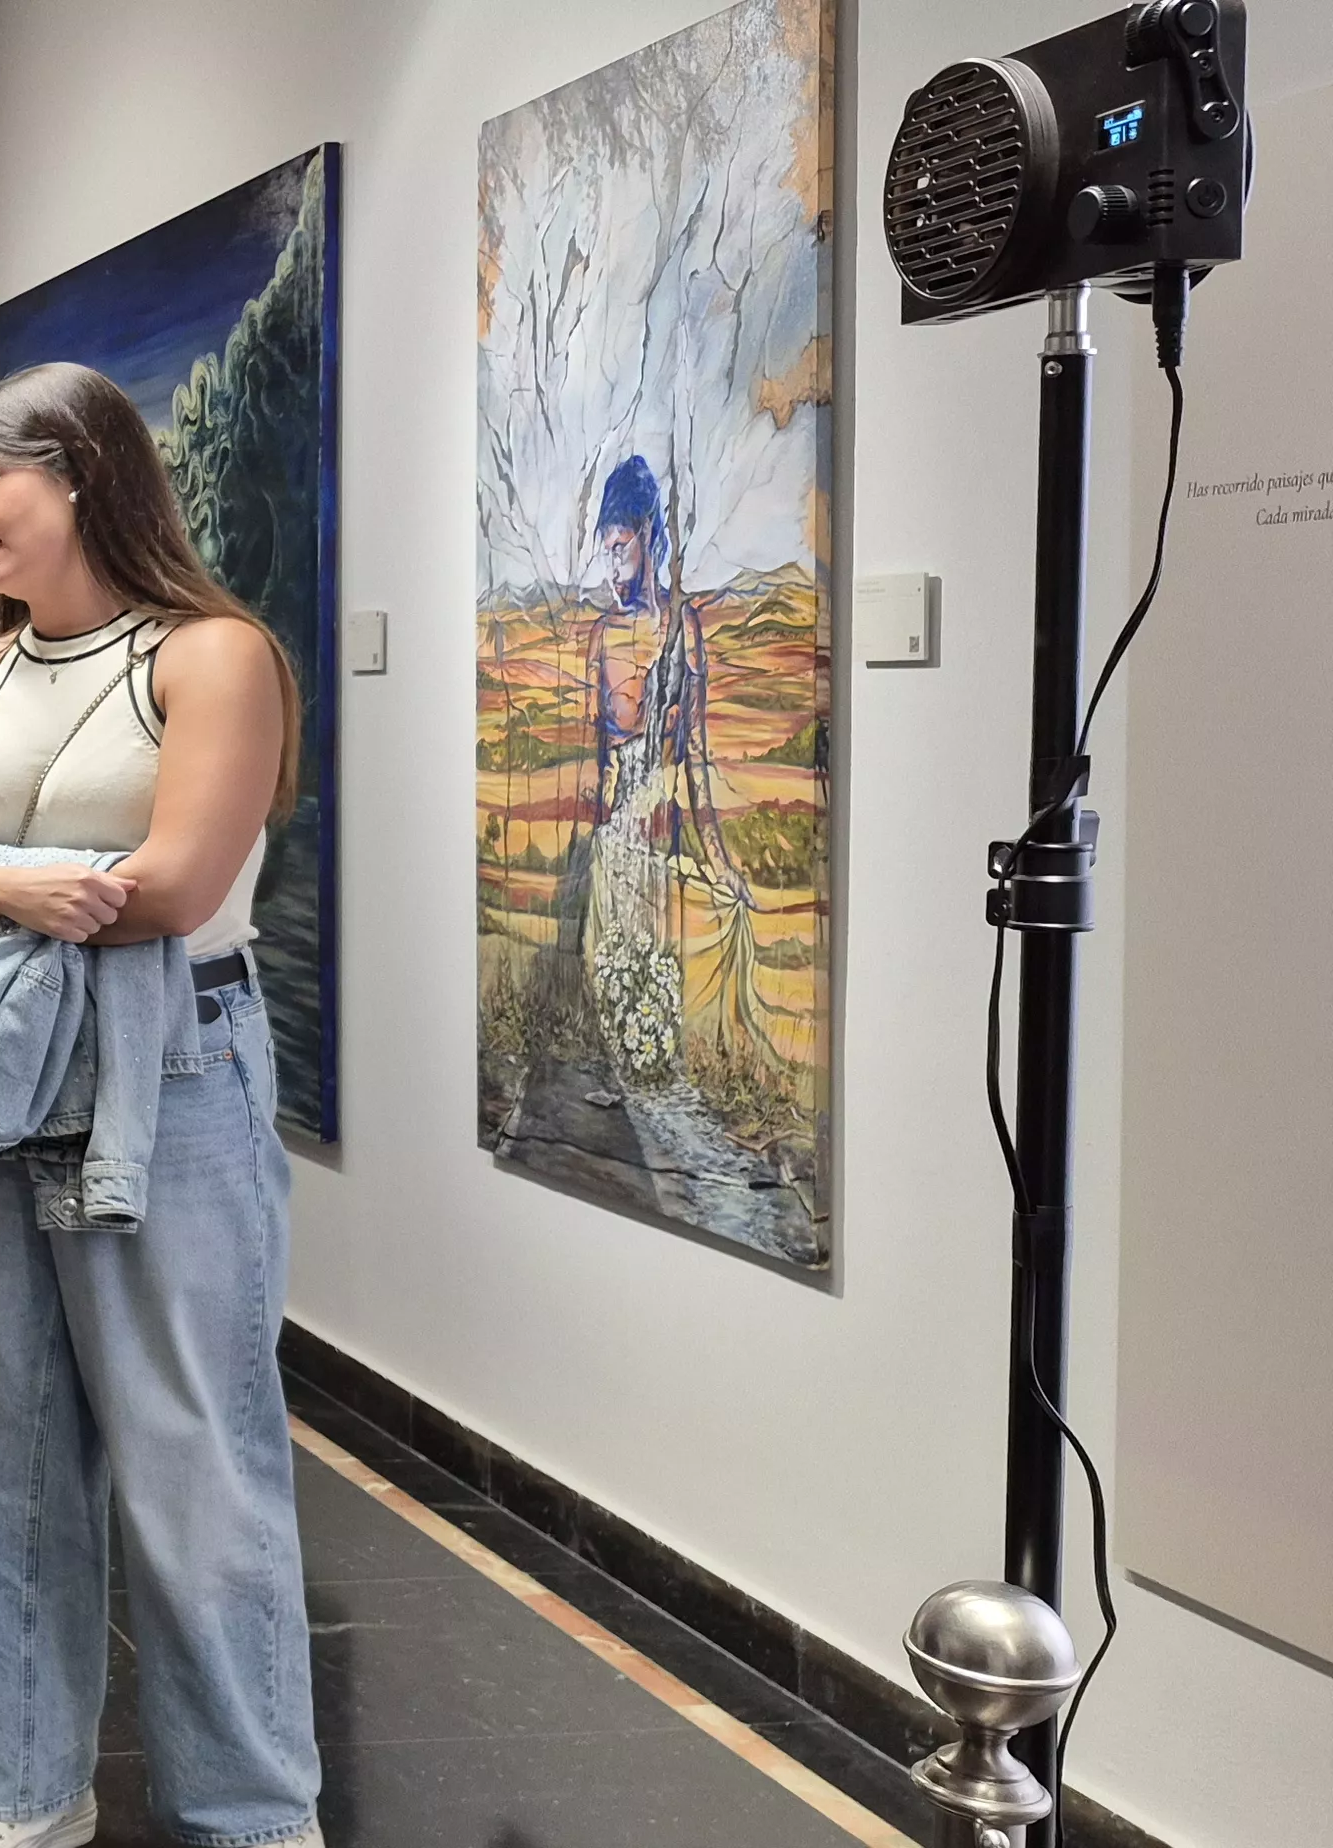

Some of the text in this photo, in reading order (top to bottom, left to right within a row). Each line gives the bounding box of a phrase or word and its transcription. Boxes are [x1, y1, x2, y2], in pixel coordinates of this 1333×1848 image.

[1187, 481, 1208, 498] Has
[1212, 473, 1264, 496] recorrido
[1266, 470, 1314, 496] paisajes
[1256, 505, 1288, 526] Cada
